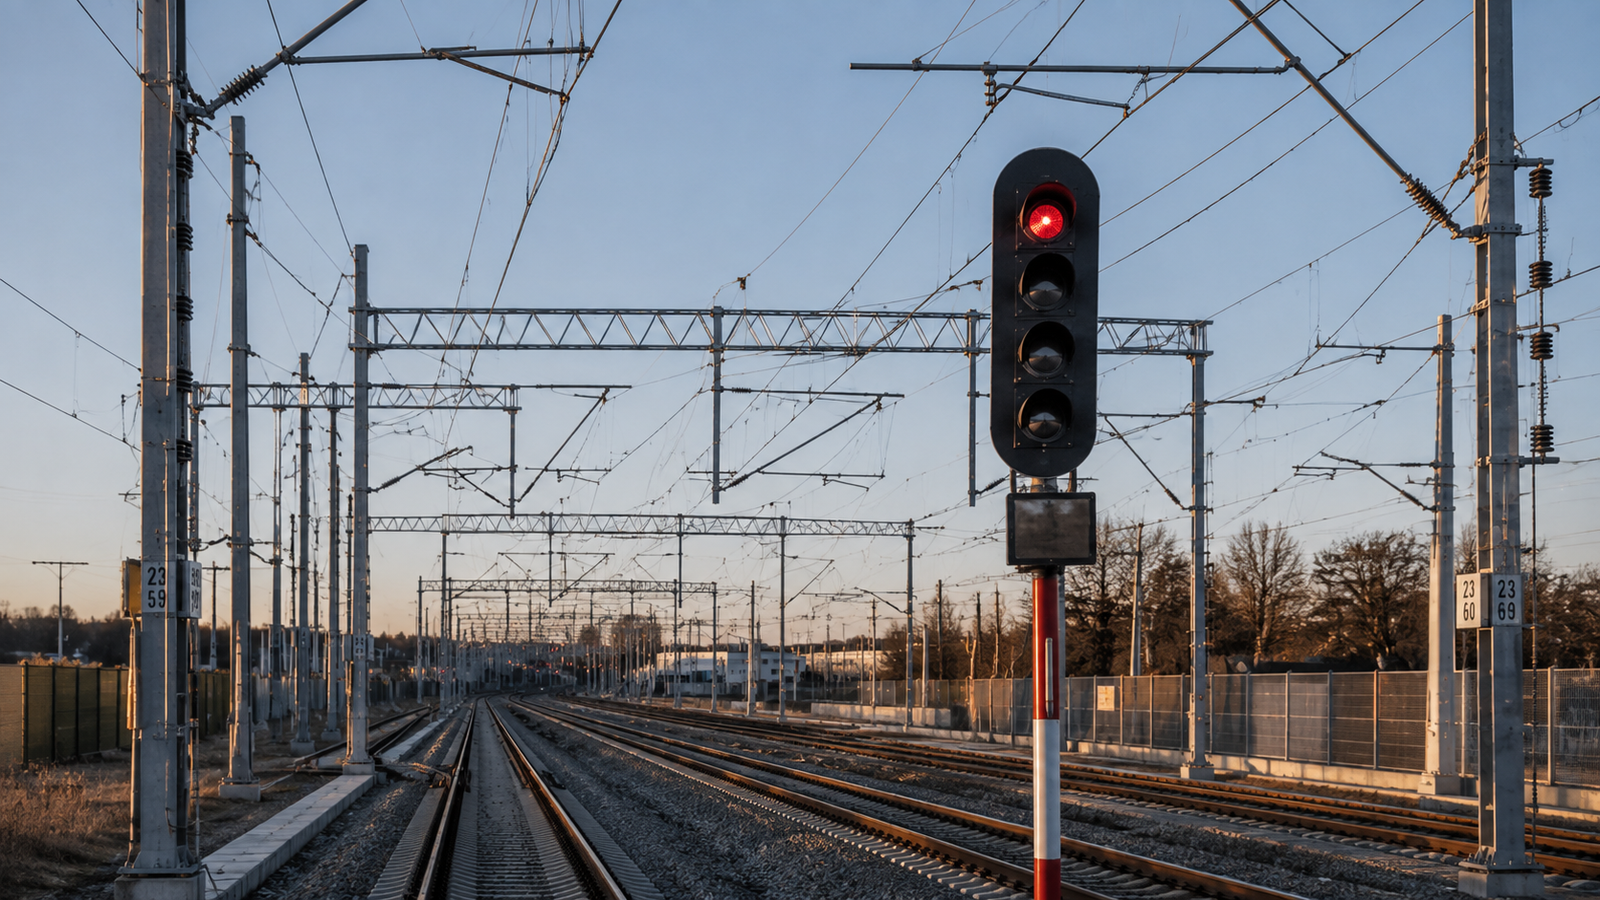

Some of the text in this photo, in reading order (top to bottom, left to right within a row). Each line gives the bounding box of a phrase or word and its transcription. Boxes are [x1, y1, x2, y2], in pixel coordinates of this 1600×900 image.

[147, 566, 166, 586] 23
[147, 589, 166, 608] 59
[1463, 580, 1475, 599] 23
[1498, 579, 1516, 599] 23
[1463, 602, 1475, 621] 60
[1498, 602, 1516, 620] 69
